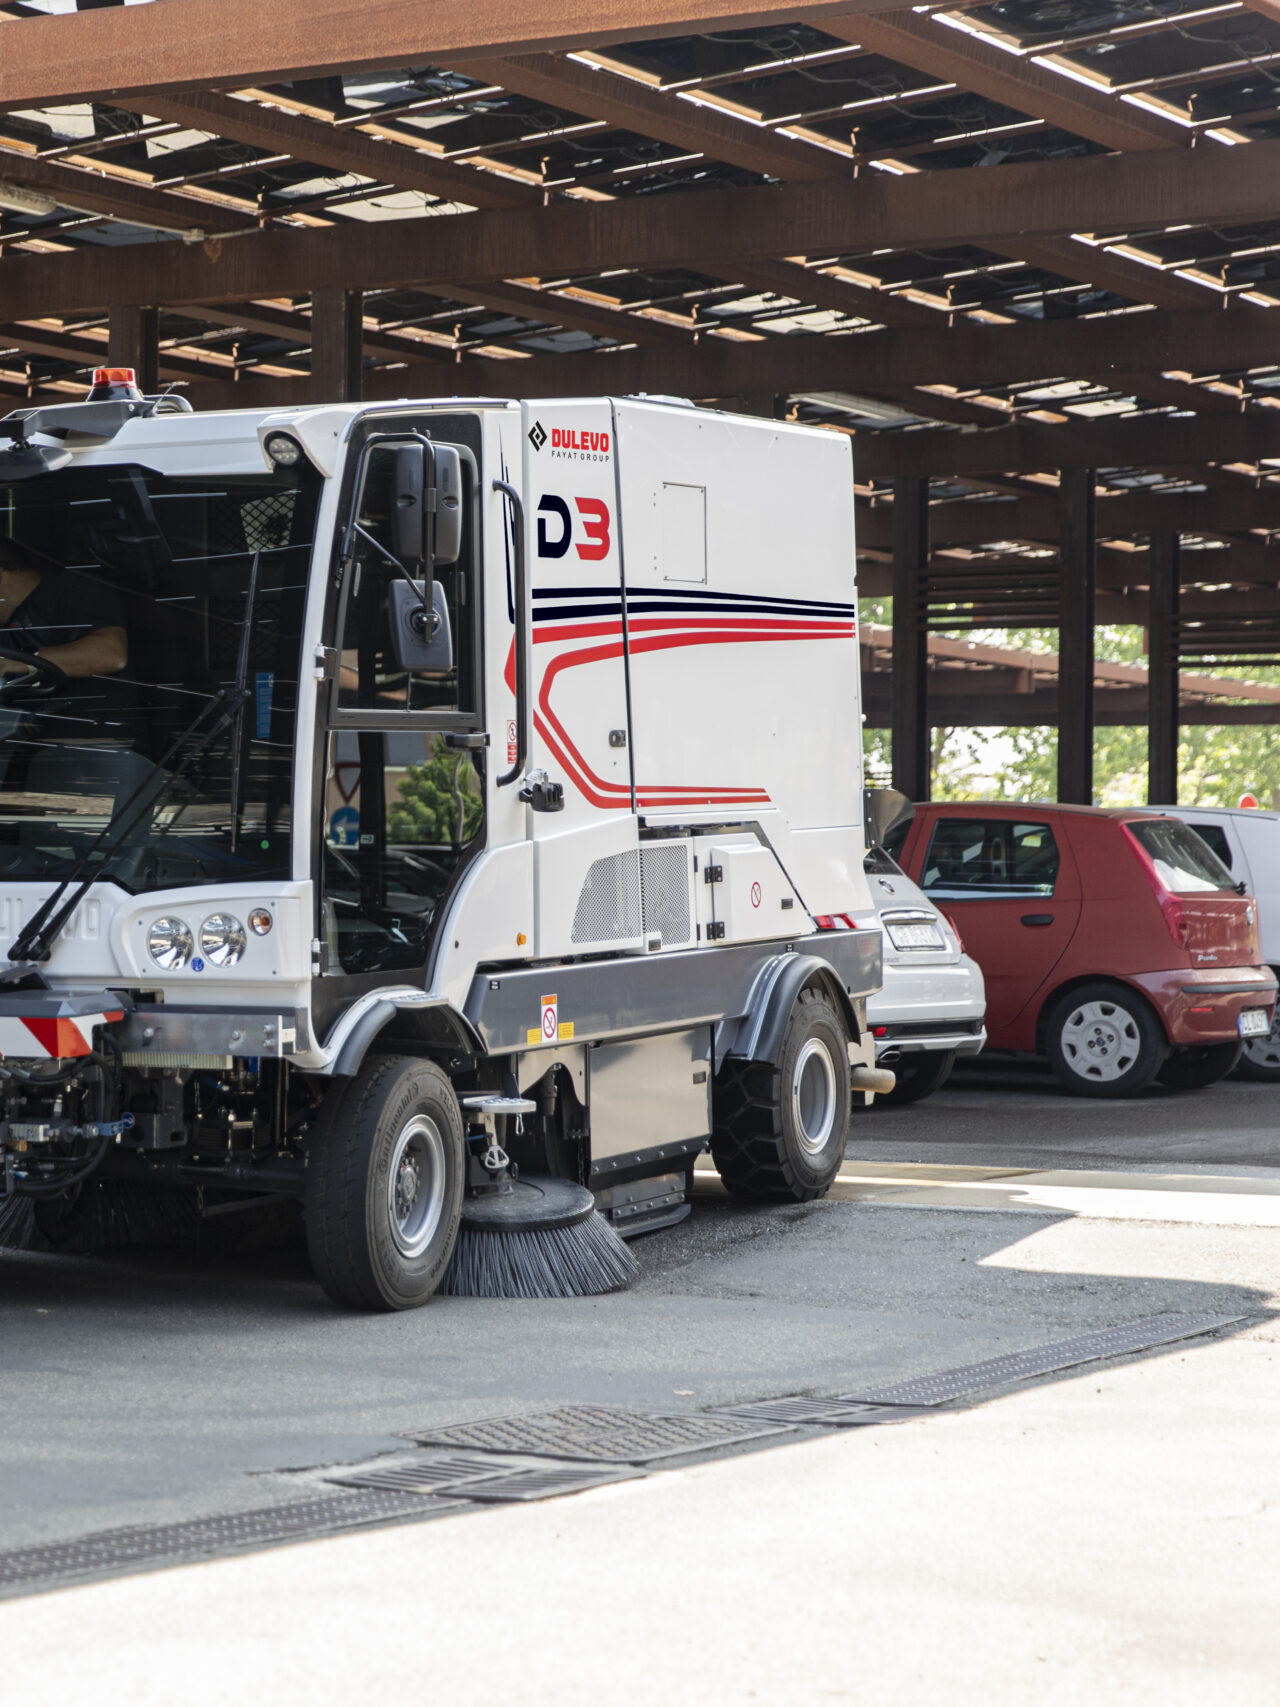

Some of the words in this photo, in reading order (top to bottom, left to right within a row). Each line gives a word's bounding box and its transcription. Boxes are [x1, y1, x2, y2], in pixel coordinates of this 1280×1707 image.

[552, 428, 609, 452] DULEVO
[551, 450, 577, 459] FAYAT
[580, 453, 609, 462] GROUP
[537, 494, 610, 561] D3
